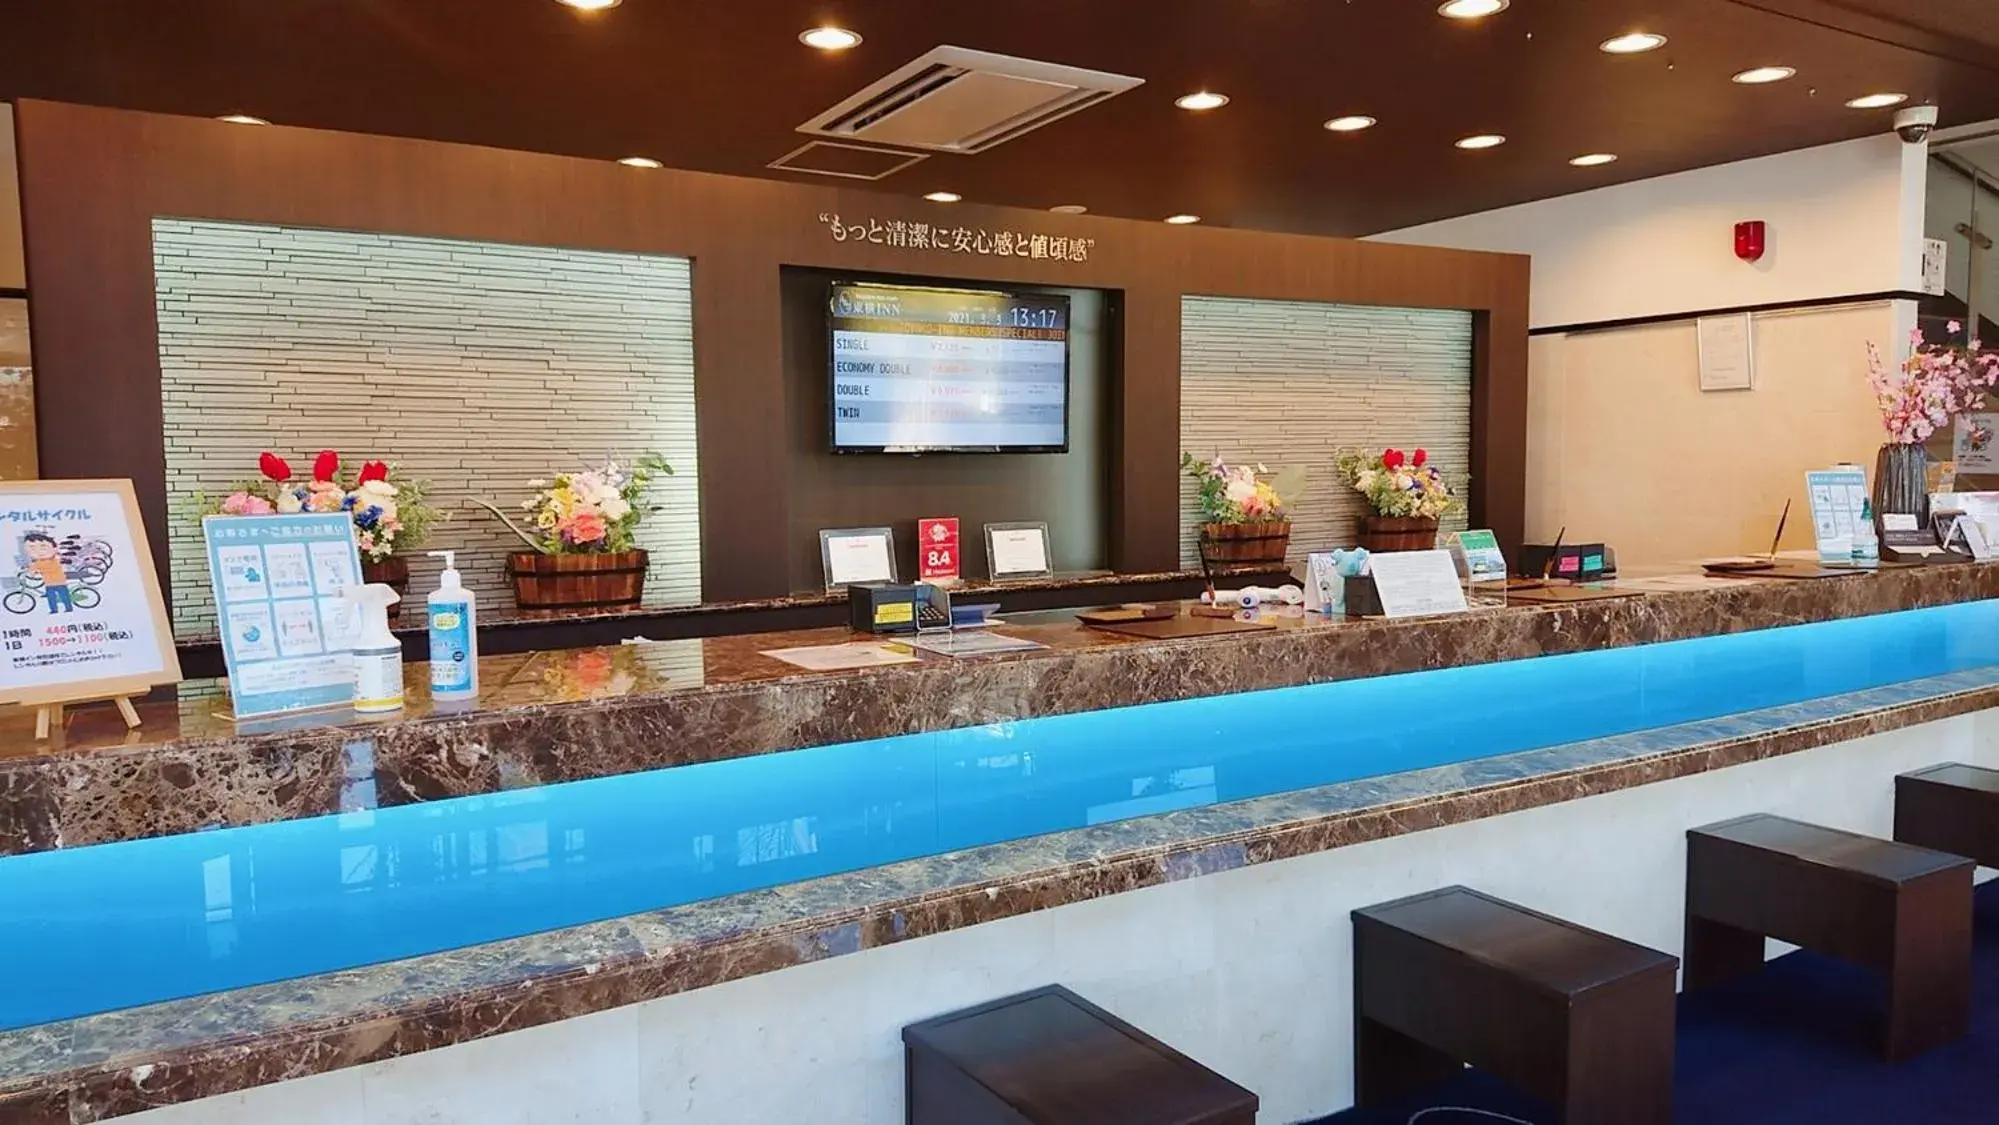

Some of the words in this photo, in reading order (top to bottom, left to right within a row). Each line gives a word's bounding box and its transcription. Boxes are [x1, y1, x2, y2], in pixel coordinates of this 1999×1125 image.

[1010, 307, 1057, 328] 13:17
[836, 338, 869, 350] SINGLE
[836, 361, 875, 374] ECONOMY
[879, 363, 912, 376] DOUBLE
[836, 384, 870, 396] DOUBLE
[837, 406, 860, 418] TWIN
[928, 550, 951, 567] 8.4
